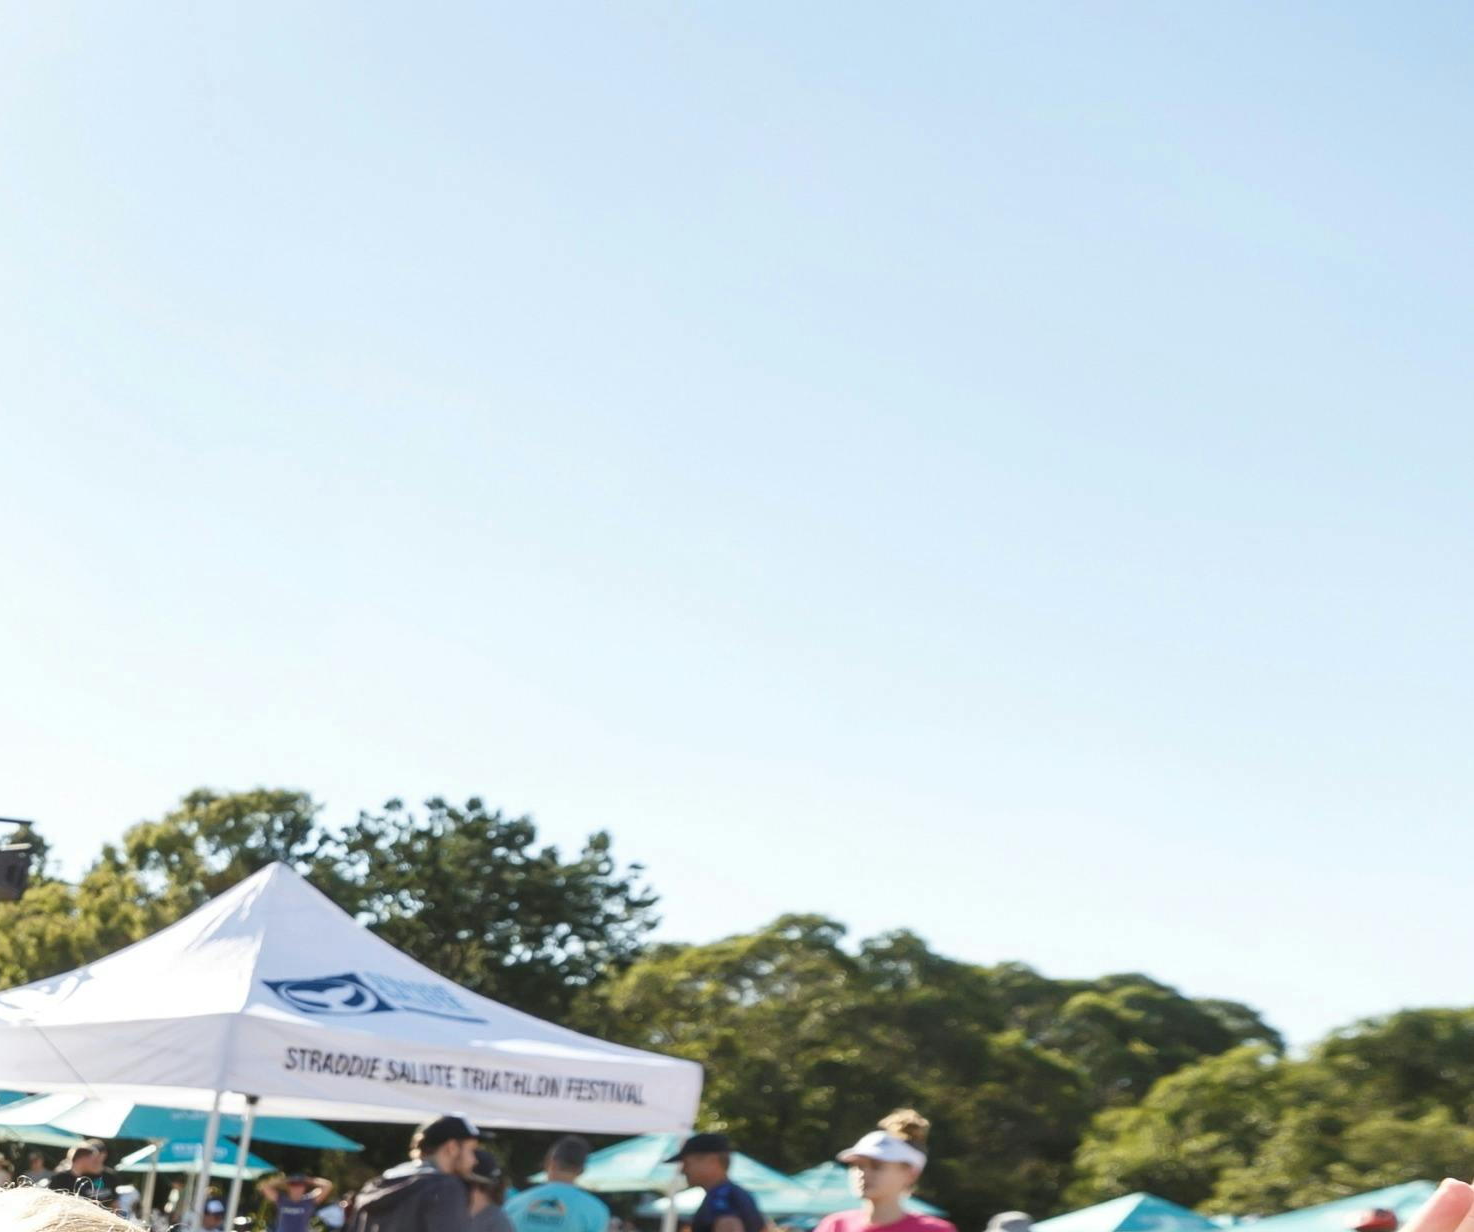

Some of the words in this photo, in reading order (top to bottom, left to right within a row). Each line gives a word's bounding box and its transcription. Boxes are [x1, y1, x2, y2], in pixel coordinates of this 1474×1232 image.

[285, 1047, 381, 1079] STRADDIE
[385, 1059, 456, 1088] SALUTE
[462, 1067, 561, 1098] TRIATHLON
[564, 1077, 647, 1105] FESTIVAL
